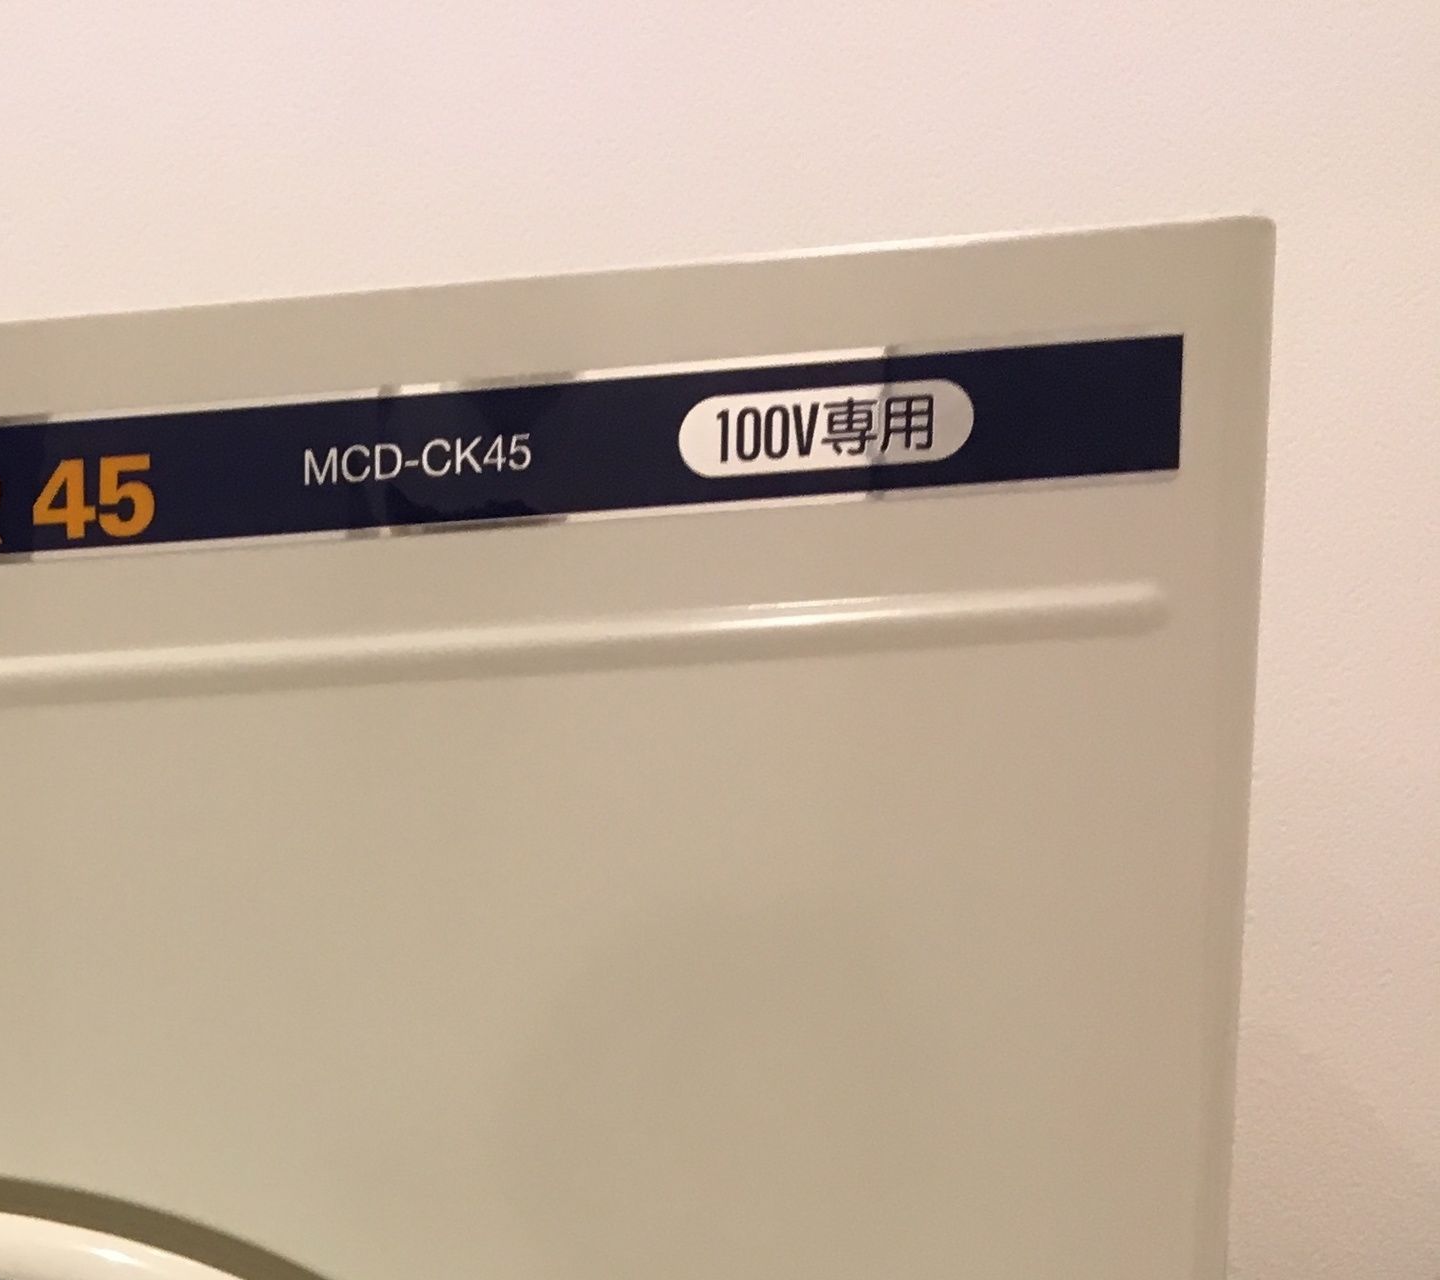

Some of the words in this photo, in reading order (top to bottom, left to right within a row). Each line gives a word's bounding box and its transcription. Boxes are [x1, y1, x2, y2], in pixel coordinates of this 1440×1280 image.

[302, 433, 533, 487] MCD-CK45
[716, 395, 935, 464] 100V専用
[31, 452, 156, 541] 45
